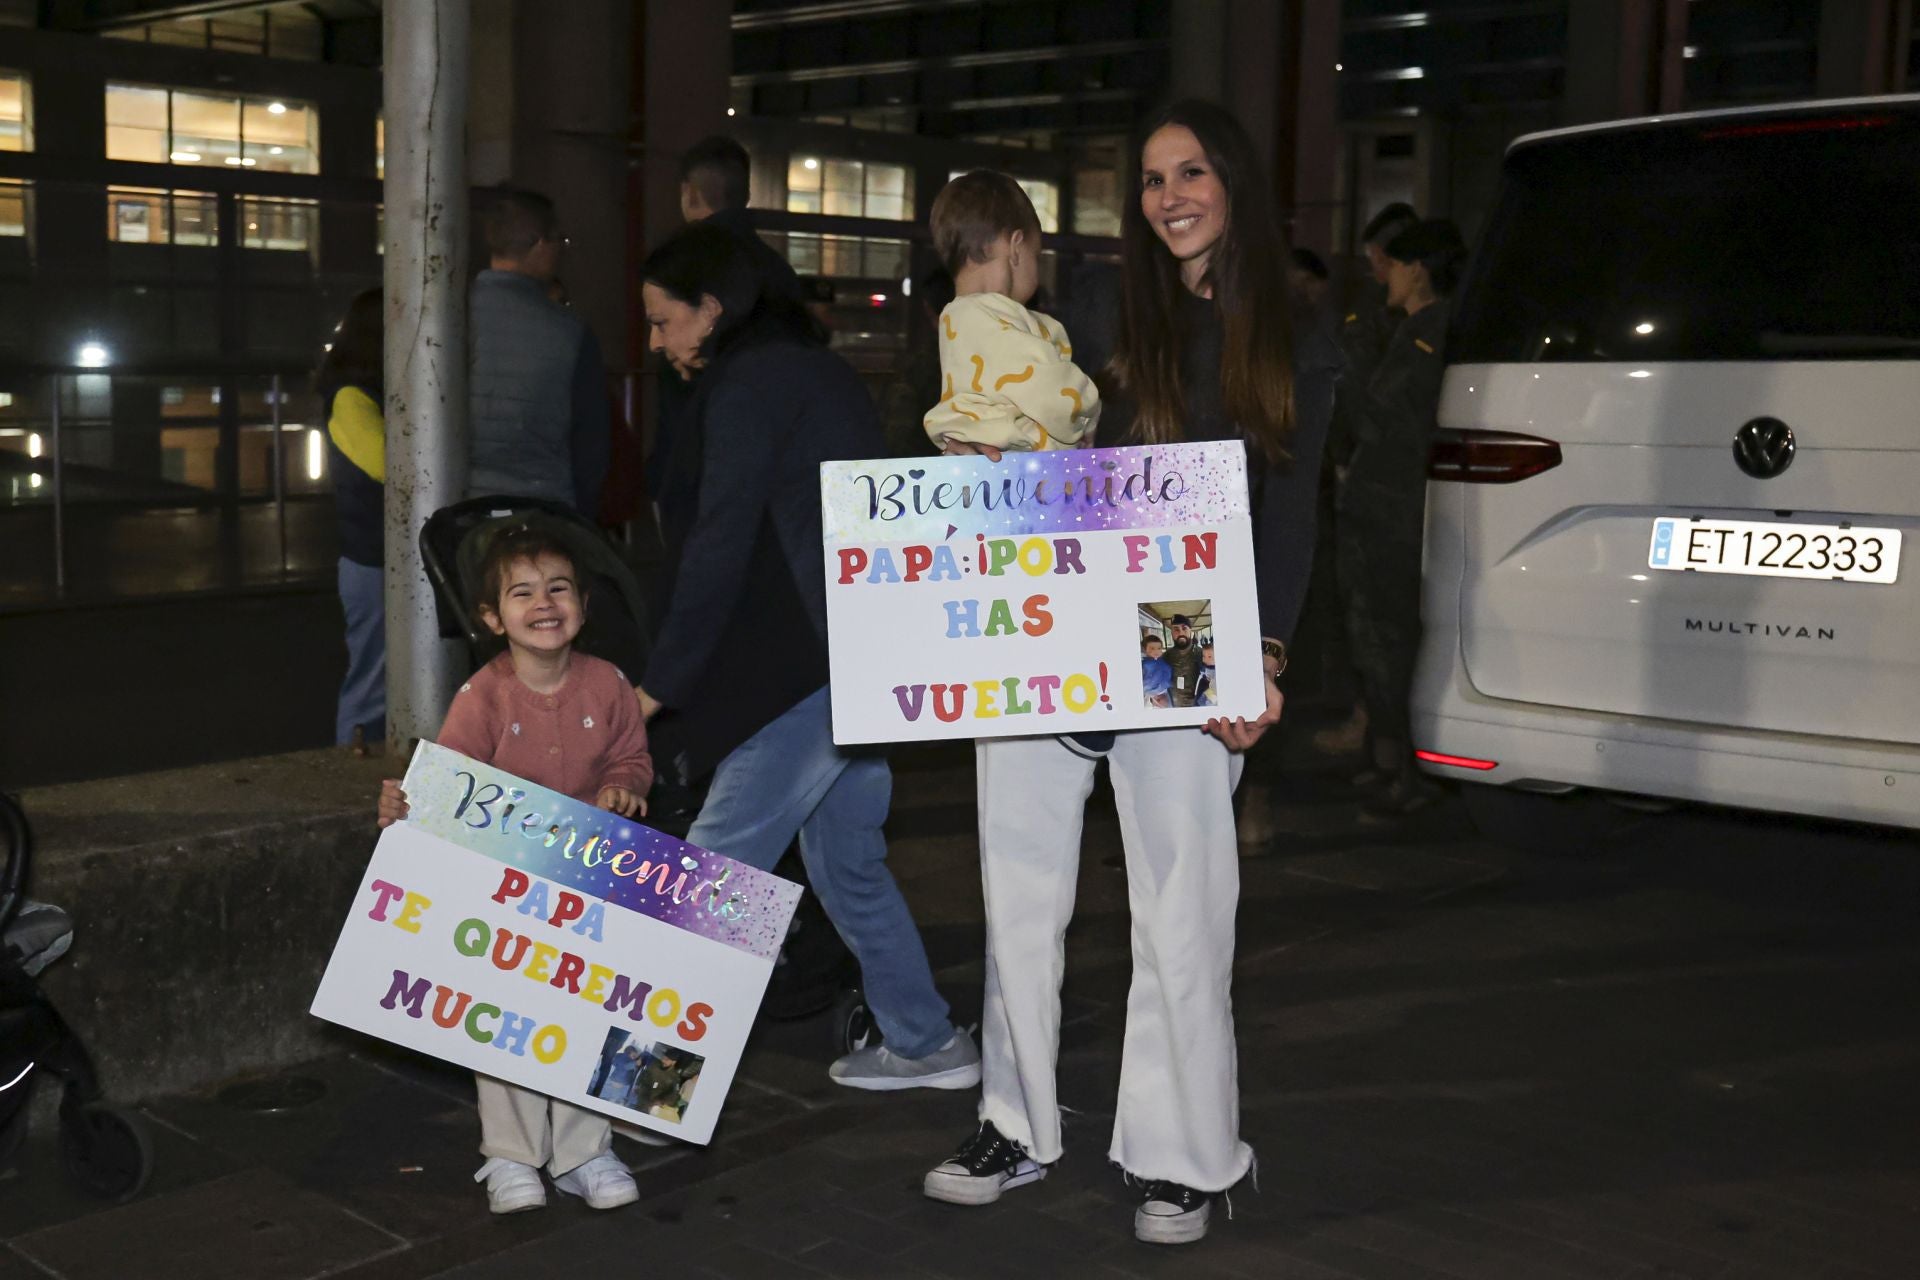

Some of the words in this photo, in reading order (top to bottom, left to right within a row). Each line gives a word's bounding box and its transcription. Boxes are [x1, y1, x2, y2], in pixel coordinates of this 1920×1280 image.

[854, 456, 1190, 521] Bienvenido
[1123, 532, 1218, 573] FIN
[1687, 528, 1884, 573] ET122333
[943, 594, 1054, 638] HAS
[1685, 618, 1835, 641] MULTIVAN
[892, 661, 1112, 722] VUELTO!
[454, 771, 751, 921] Bienvenido
[368, 878, 432, 934] TE
[453, 917, 714, 1042] QUEREMOS
[379, 969, 568, 1065] MUCHO
